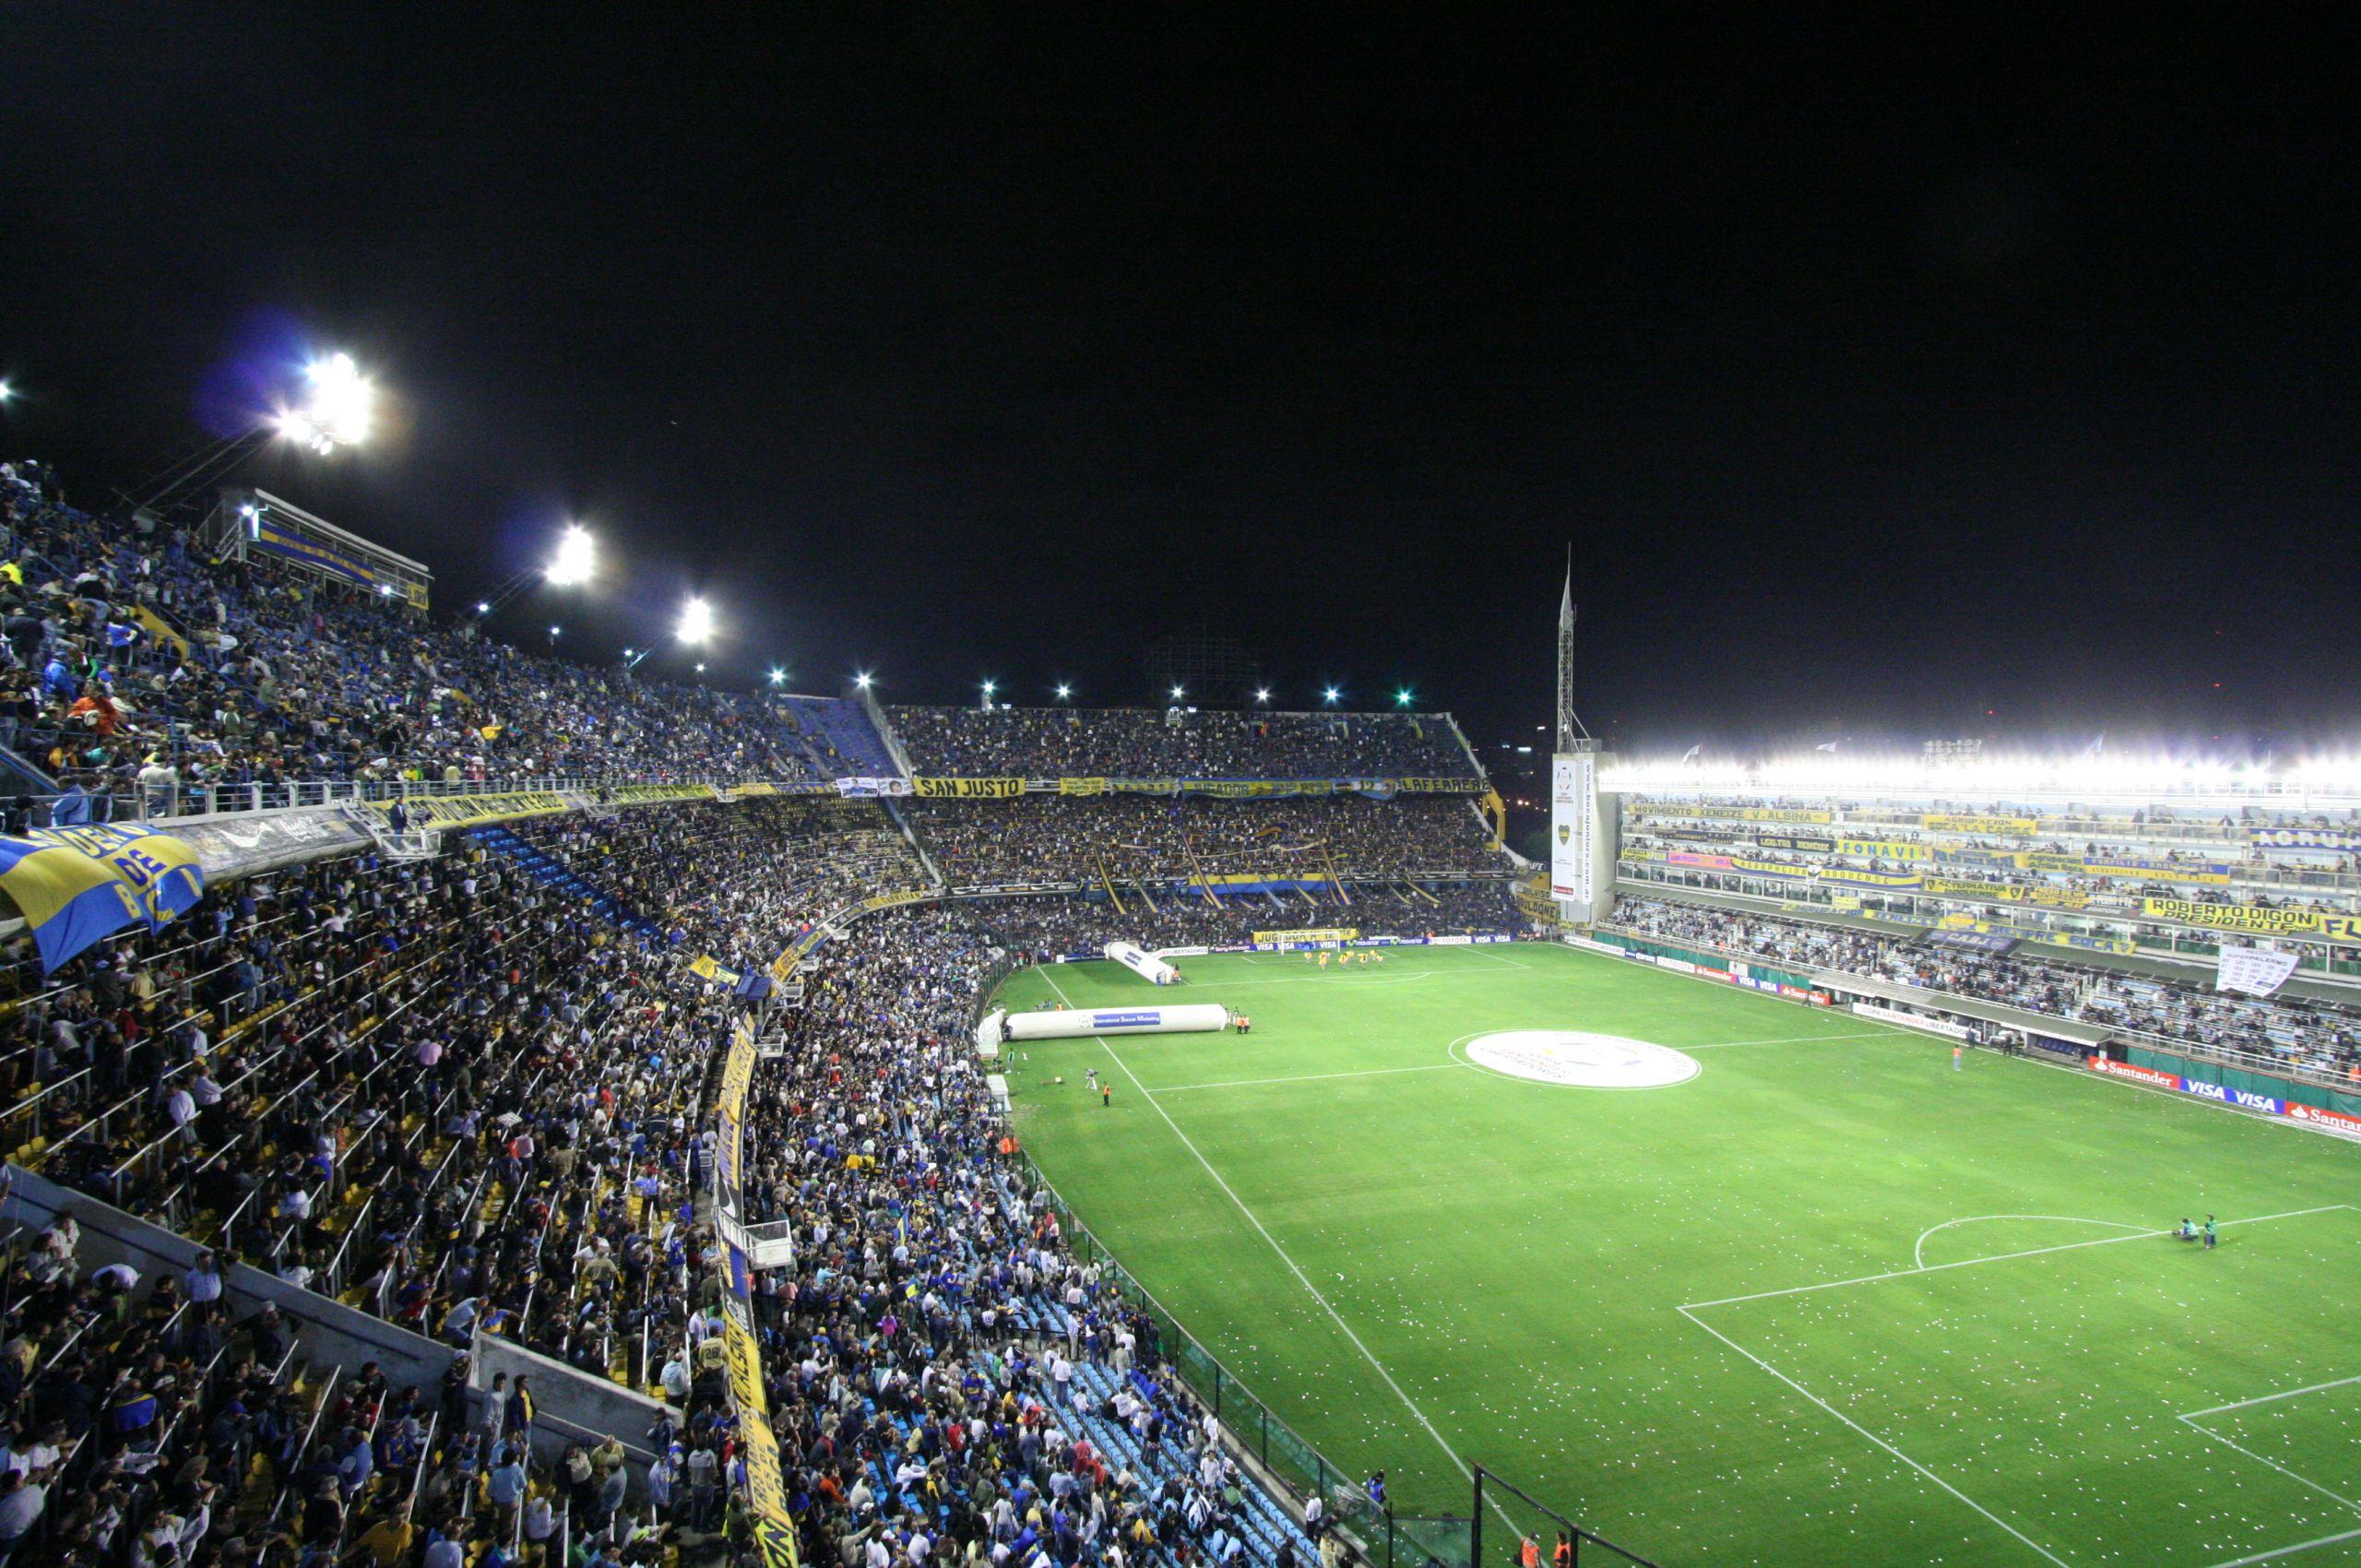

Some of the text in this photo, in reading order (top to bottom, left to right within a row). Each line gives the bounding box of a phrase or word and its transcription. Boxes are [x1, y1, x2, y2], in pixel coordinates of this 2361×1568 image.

[922, 779, 957, 796] SAN
[962, 778, 1018, 797] JUSTO
[1634, 805, 1691, 815] MOVIMIENTO
[1699, 809, 1745, 819] XENEIZE
[1844, 843, 1916, 859] FONAVI
[113, 849, 167, 885] DE
[1823, 869, 1890, 885] BOQUENSE
[2153, 899, 2245, 918] ROBERTO
[2248, 907, 2313, 925] DIGON
[2164, 910, 2292, 932] PRESIDENTE
[1257, 943, 1274, 951] VISA
[1703, 968, 1733, 981] Santander
[1738, 975, 1756, 987] VISA
[1759, 980, 1778, 992] VISA
[1862, 1007, 1881, 1017] COPA
[1882, 1011, 1925, 1027] SANTANDER
[2107, 1062, 2172, 1087] Santander
[2186, 1078, 2225, 1100] VISA
[2235, 1091, 2276, 1112] VISA
[705, 1347, 718, 1360] 26
